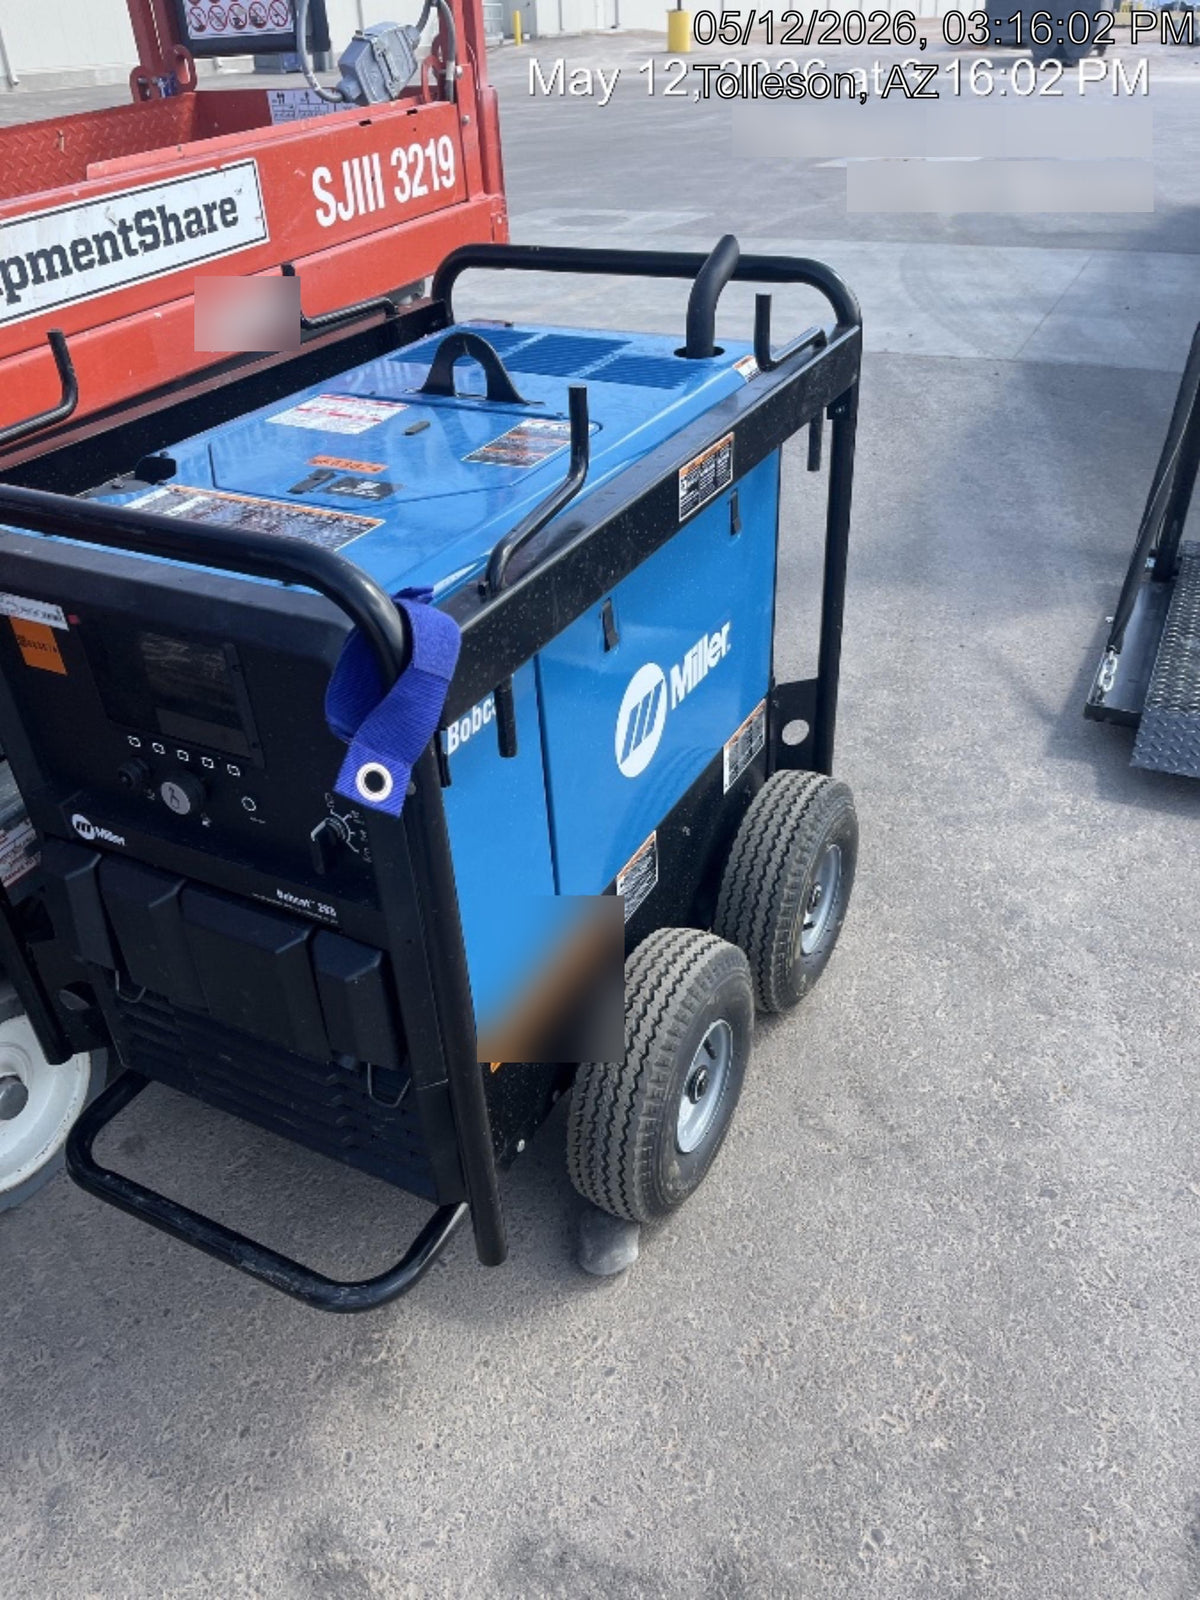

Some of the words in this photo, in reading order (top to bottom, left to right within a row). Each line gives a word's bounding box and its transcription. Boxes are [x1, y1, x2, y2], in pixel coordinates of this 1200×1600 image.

[312, 152, 386, 227] SJIII
[390, 134, 456, 203] 3219
[0, 196, 239, 306] pmentShare
[670, 621, 731, 710] Miller
[447, 697, 497, 756] Bobc
